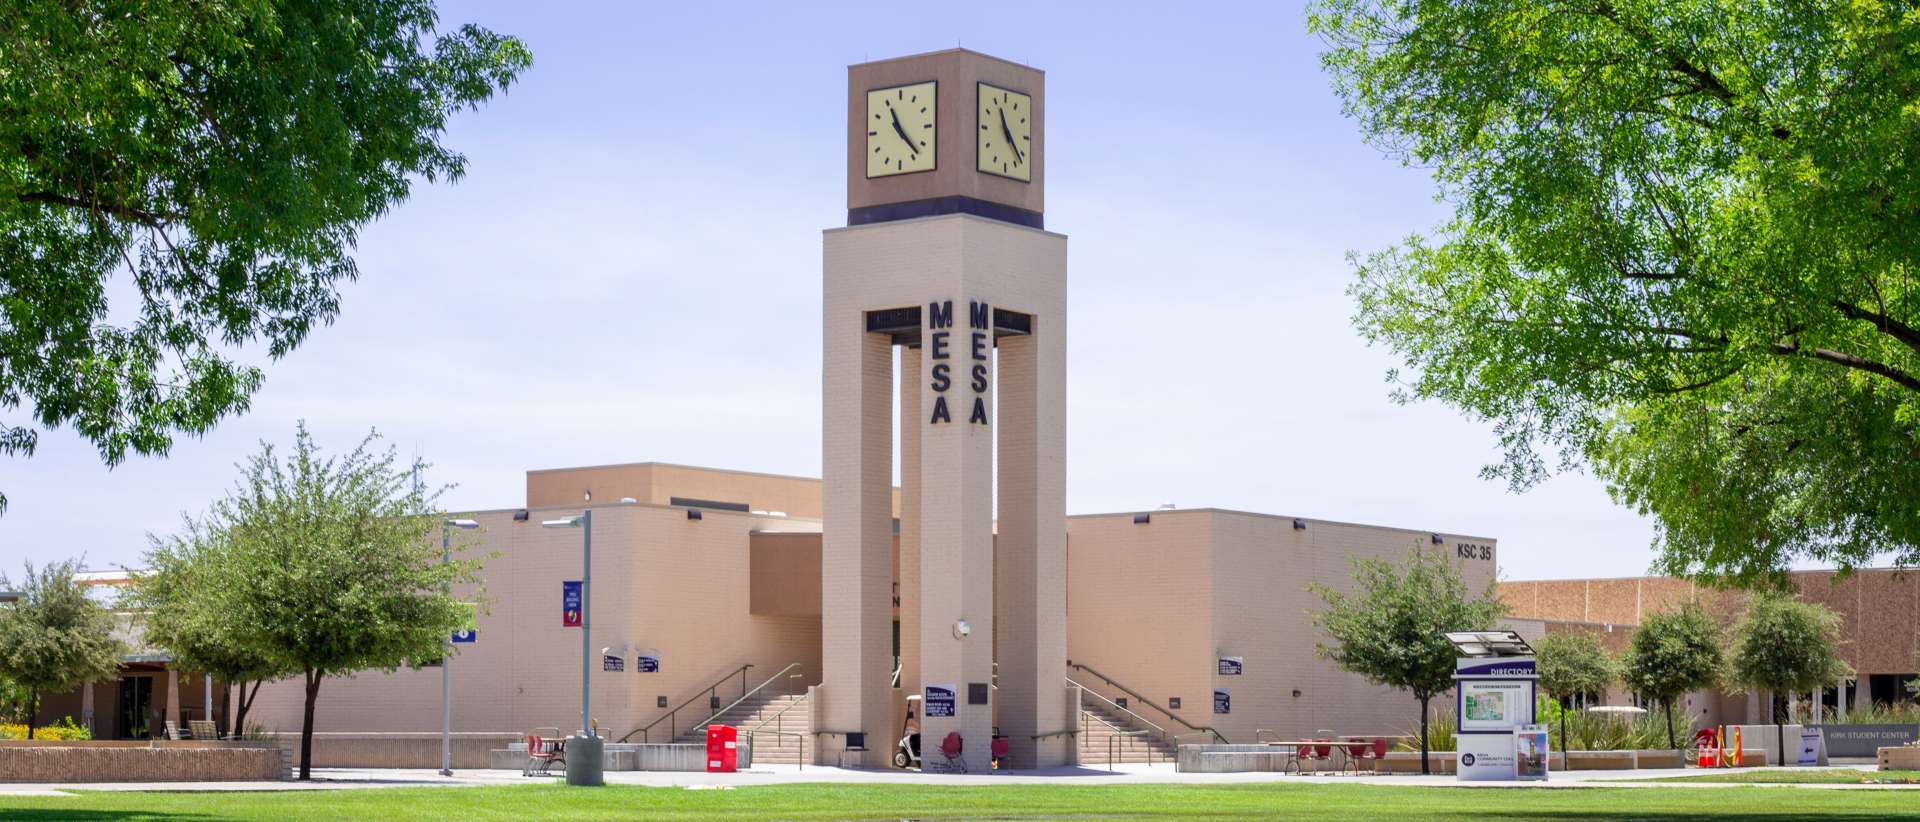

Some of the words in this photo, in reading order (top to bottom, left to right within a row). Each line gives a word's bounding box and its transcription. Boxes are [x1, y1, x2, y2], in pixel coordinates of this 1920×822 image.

[929, 300, 953, 424] MESA
[969, 301, 988, 425] MESA
[1457, 543, 1477, 559] KSC
[1479, 545, 1492, 561] 35
[1490, 668, 1533, 676] DIRECTORY
[1847, 731, 1880, 739] STUDENT
[1881, 731, 1910, 739] CENTER
